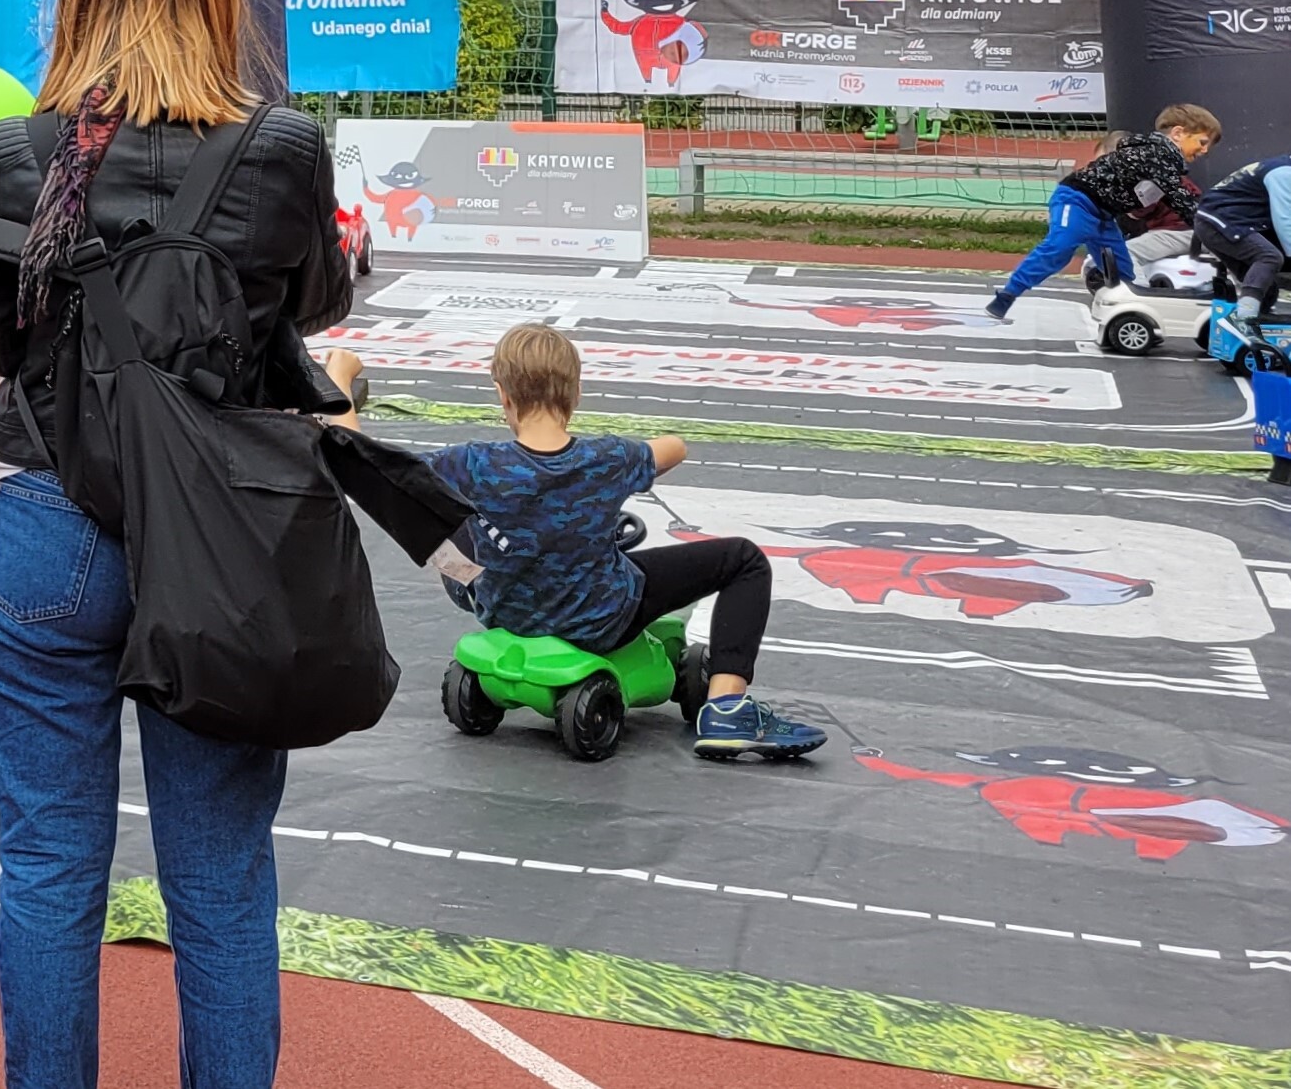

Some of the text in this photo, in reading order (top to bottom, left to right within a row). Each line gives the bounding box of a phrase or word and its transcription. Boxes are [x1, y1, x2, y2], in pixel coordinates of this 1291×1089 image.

[920, 8, 1001, 22] dla odmiany
[312, 19, 431, 37] Udanego dnia!
[750, 30, 857, 50] GKFORGE
[750, 49, 785, 59] Kuźnia
[986, 47, 1012, 56] KSSE
[1072, 49, 1097, 60] LOTTO
[843, 78, 860, 88] 112
[898, 78, 944, 87] DZIENNIK
[985, 84, 1018, 92] POLICJA
[527, 155, 615, 169] KATOWICE
